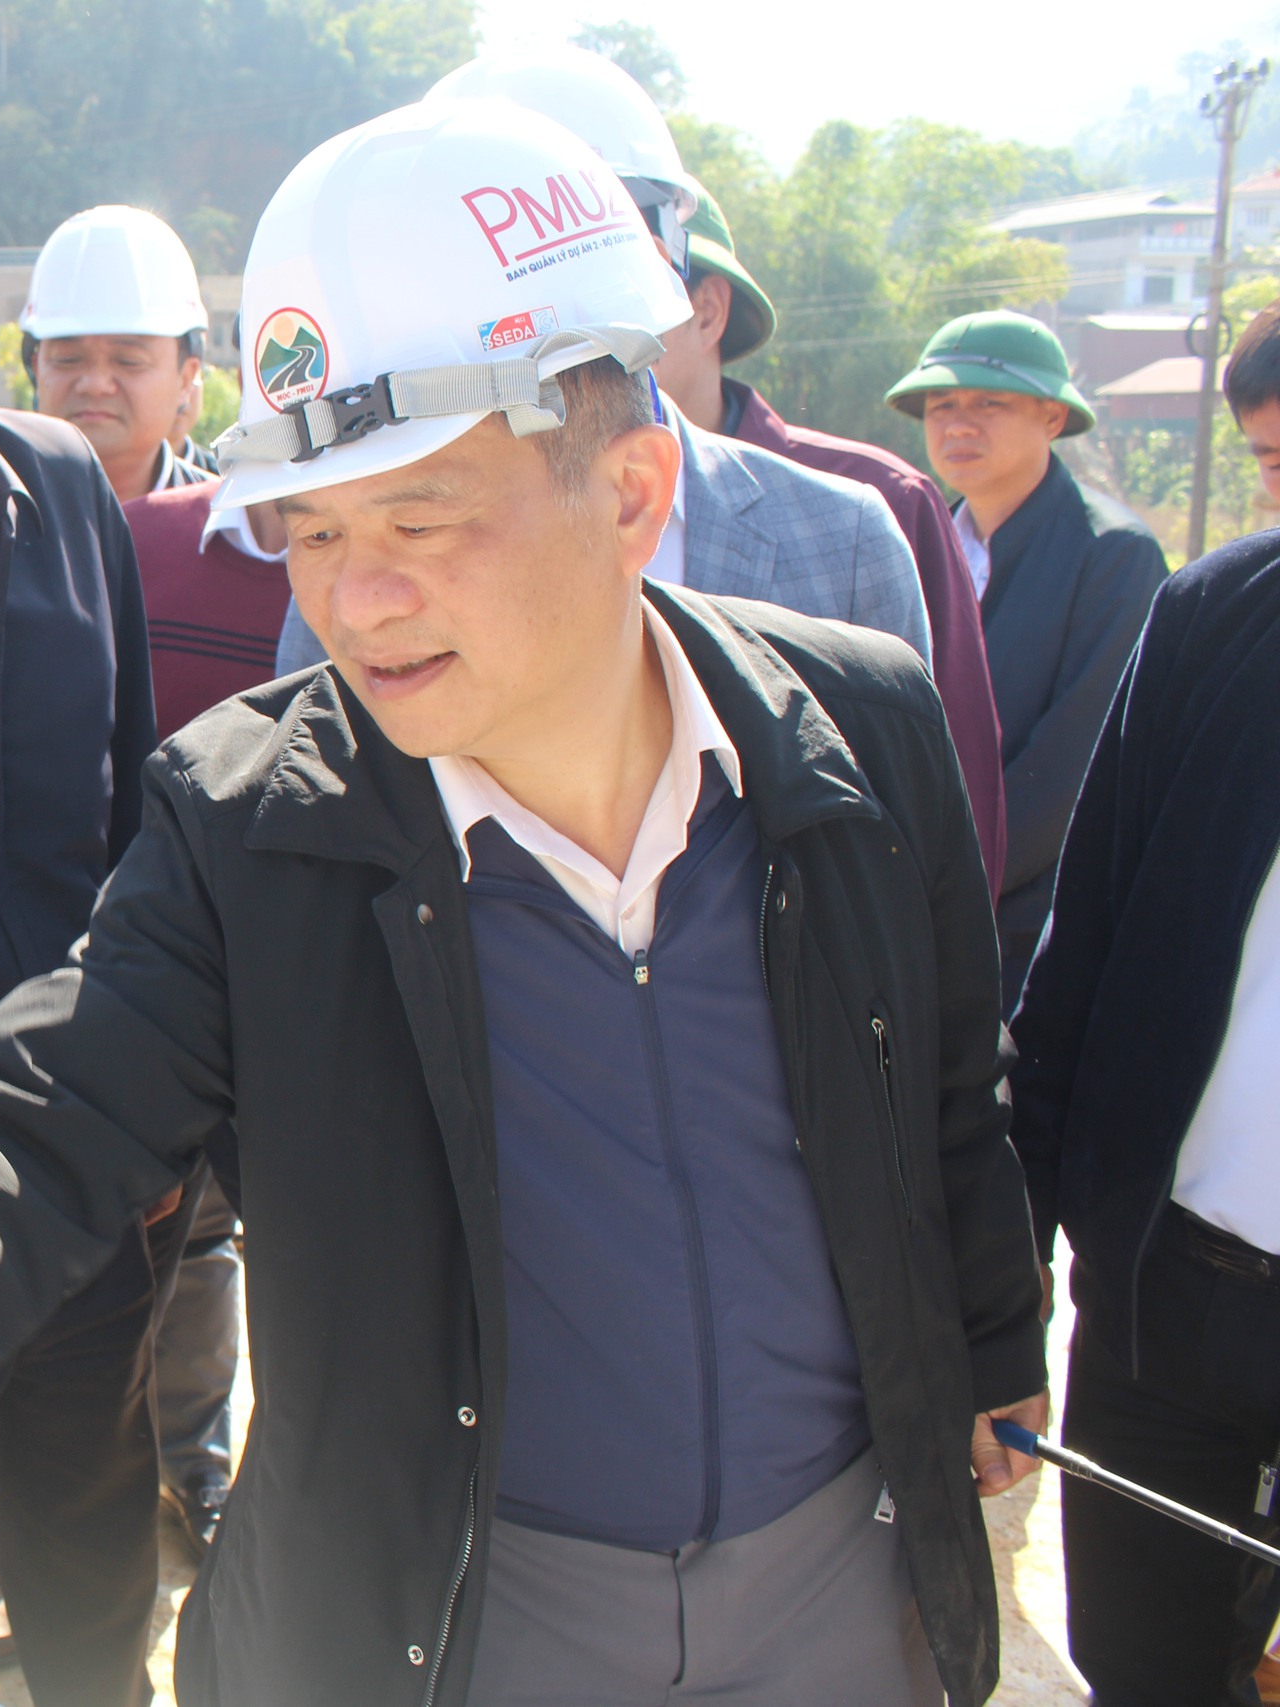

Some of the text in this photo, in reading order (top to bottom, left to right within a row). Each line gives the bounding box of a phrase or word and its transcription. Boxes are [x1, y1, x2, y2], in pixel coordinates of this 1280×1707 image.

[506, 266, 528, 282] BAN
[528, 255, 557, 273] QUẢN
[556, 249, 568, 263] LÝ
[567, 246, 581, 259] DỰ
[581, 242, 593, 254] ÁN
[593, 241, 600, 250] 2
[602, 235, 613, 249] BỘ
[482, 325, 535, 349] SSEDA
